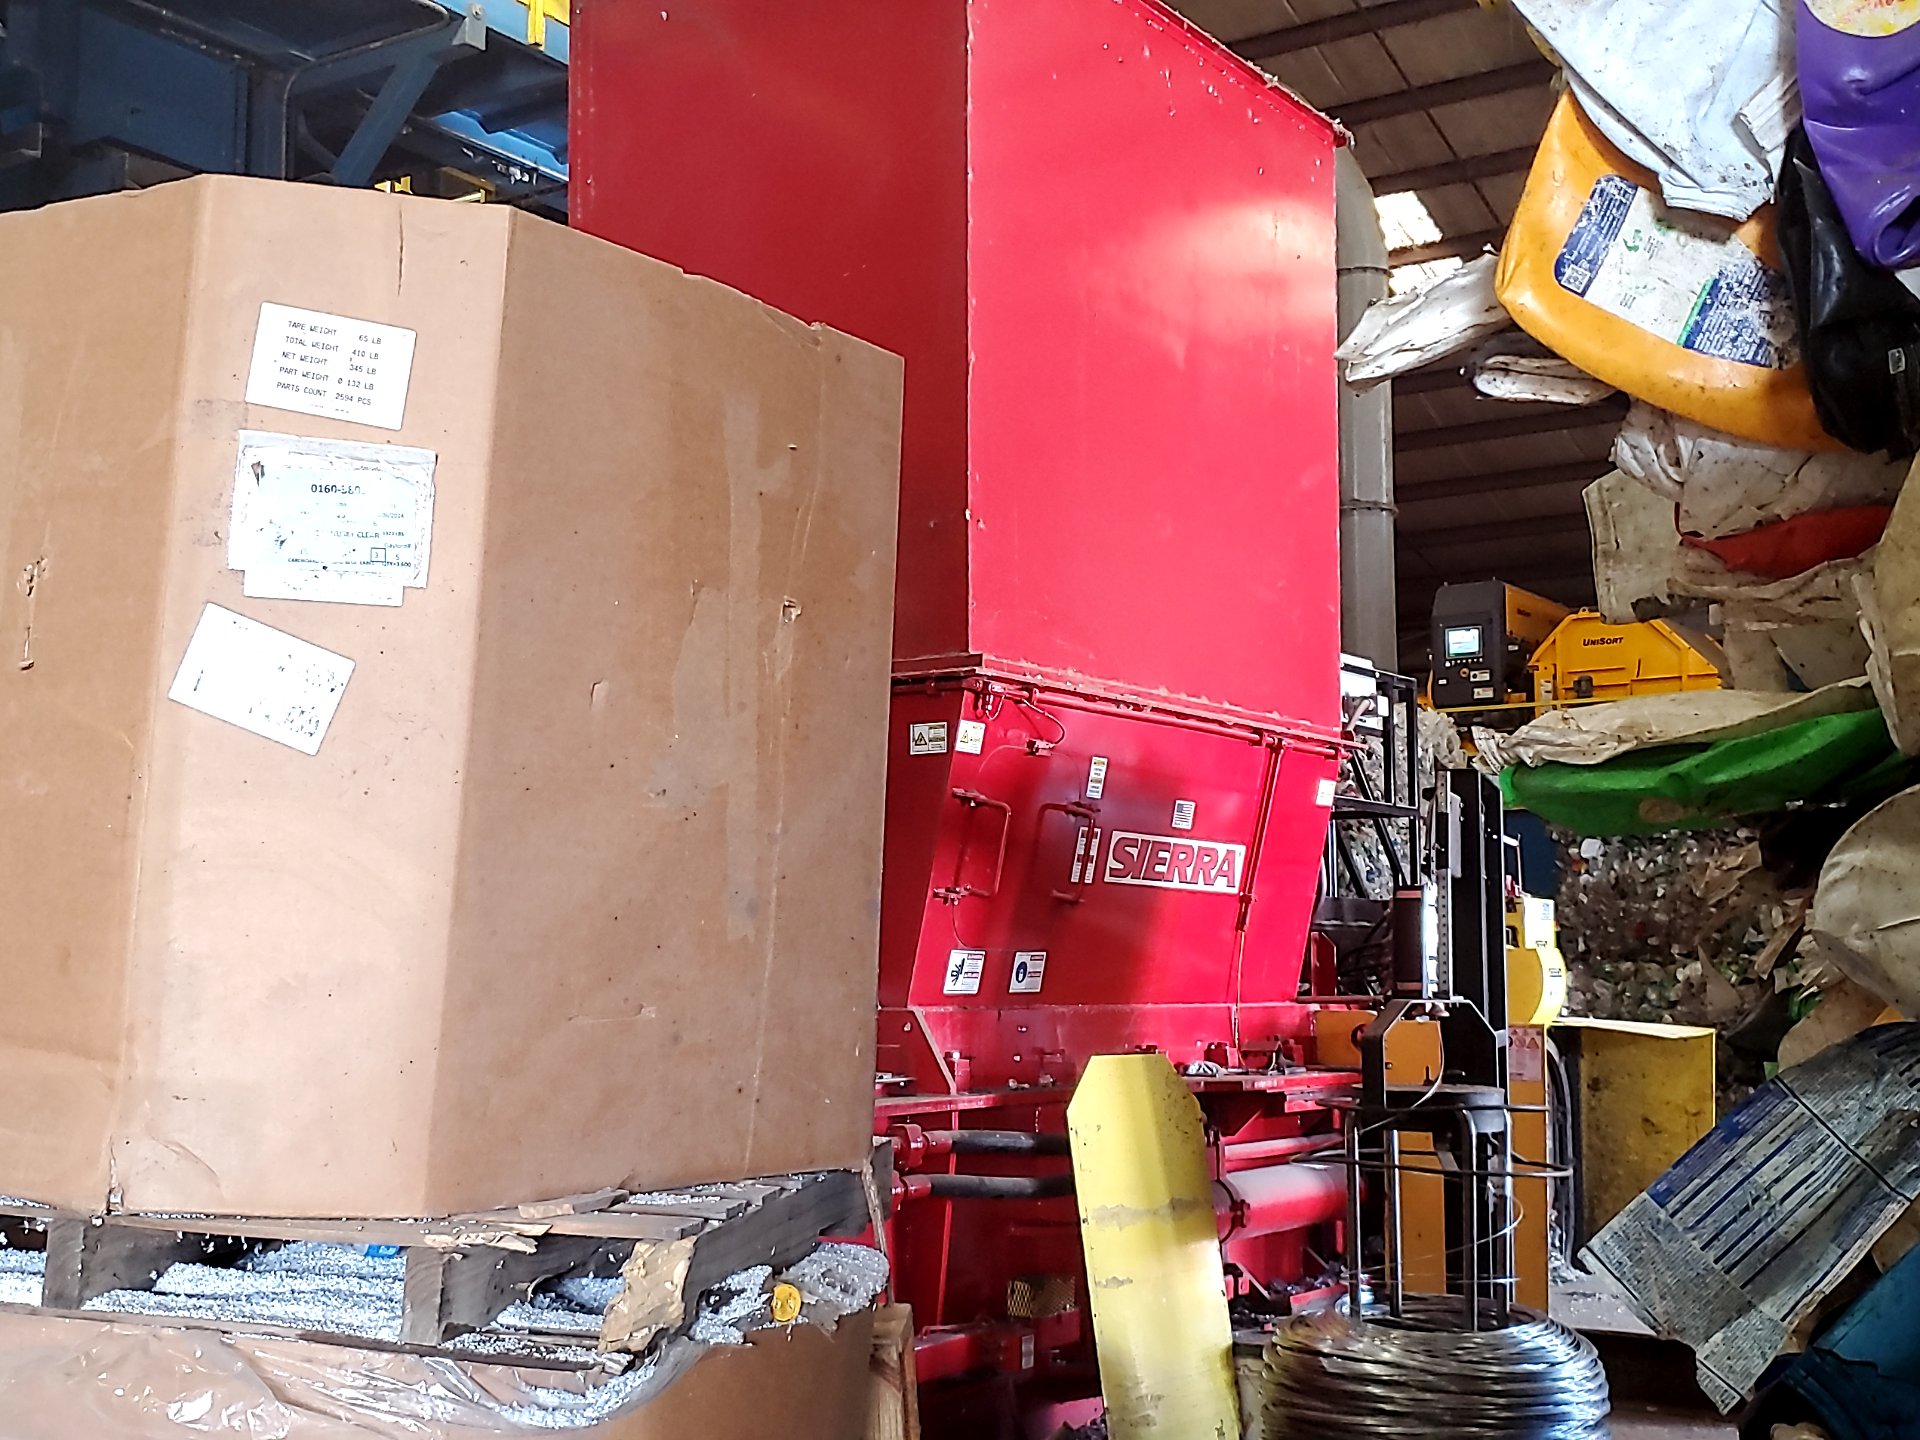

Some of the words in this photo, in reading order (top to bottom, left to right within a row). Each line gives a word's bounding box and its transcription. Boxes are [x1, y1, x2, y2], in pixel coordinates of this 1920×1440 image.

[310, 325, 337, 336] WEIGHT
[285, 336, 307, 346] TOTAL
[311, 341, 339, 352] WEIGHT
[352, 349, 365, 357] 410
[369, 352, 379, 360] LB
[282, 351, 296, 360] NET
[300, 355, 328, 365] WEIGHT
[349, 364, 363, 372] 345
[279, 366, 298, 376] PART
[302, 371, 329, 381] WEIGHT
[277, 381, 300, 392] PARTS
[303, 386, 327, 397] COUNT
[335, 392, 354, 402] 2594
[357, 396, 372, 406] PCS
[1109, 837, 1236, 888] SIERRA
